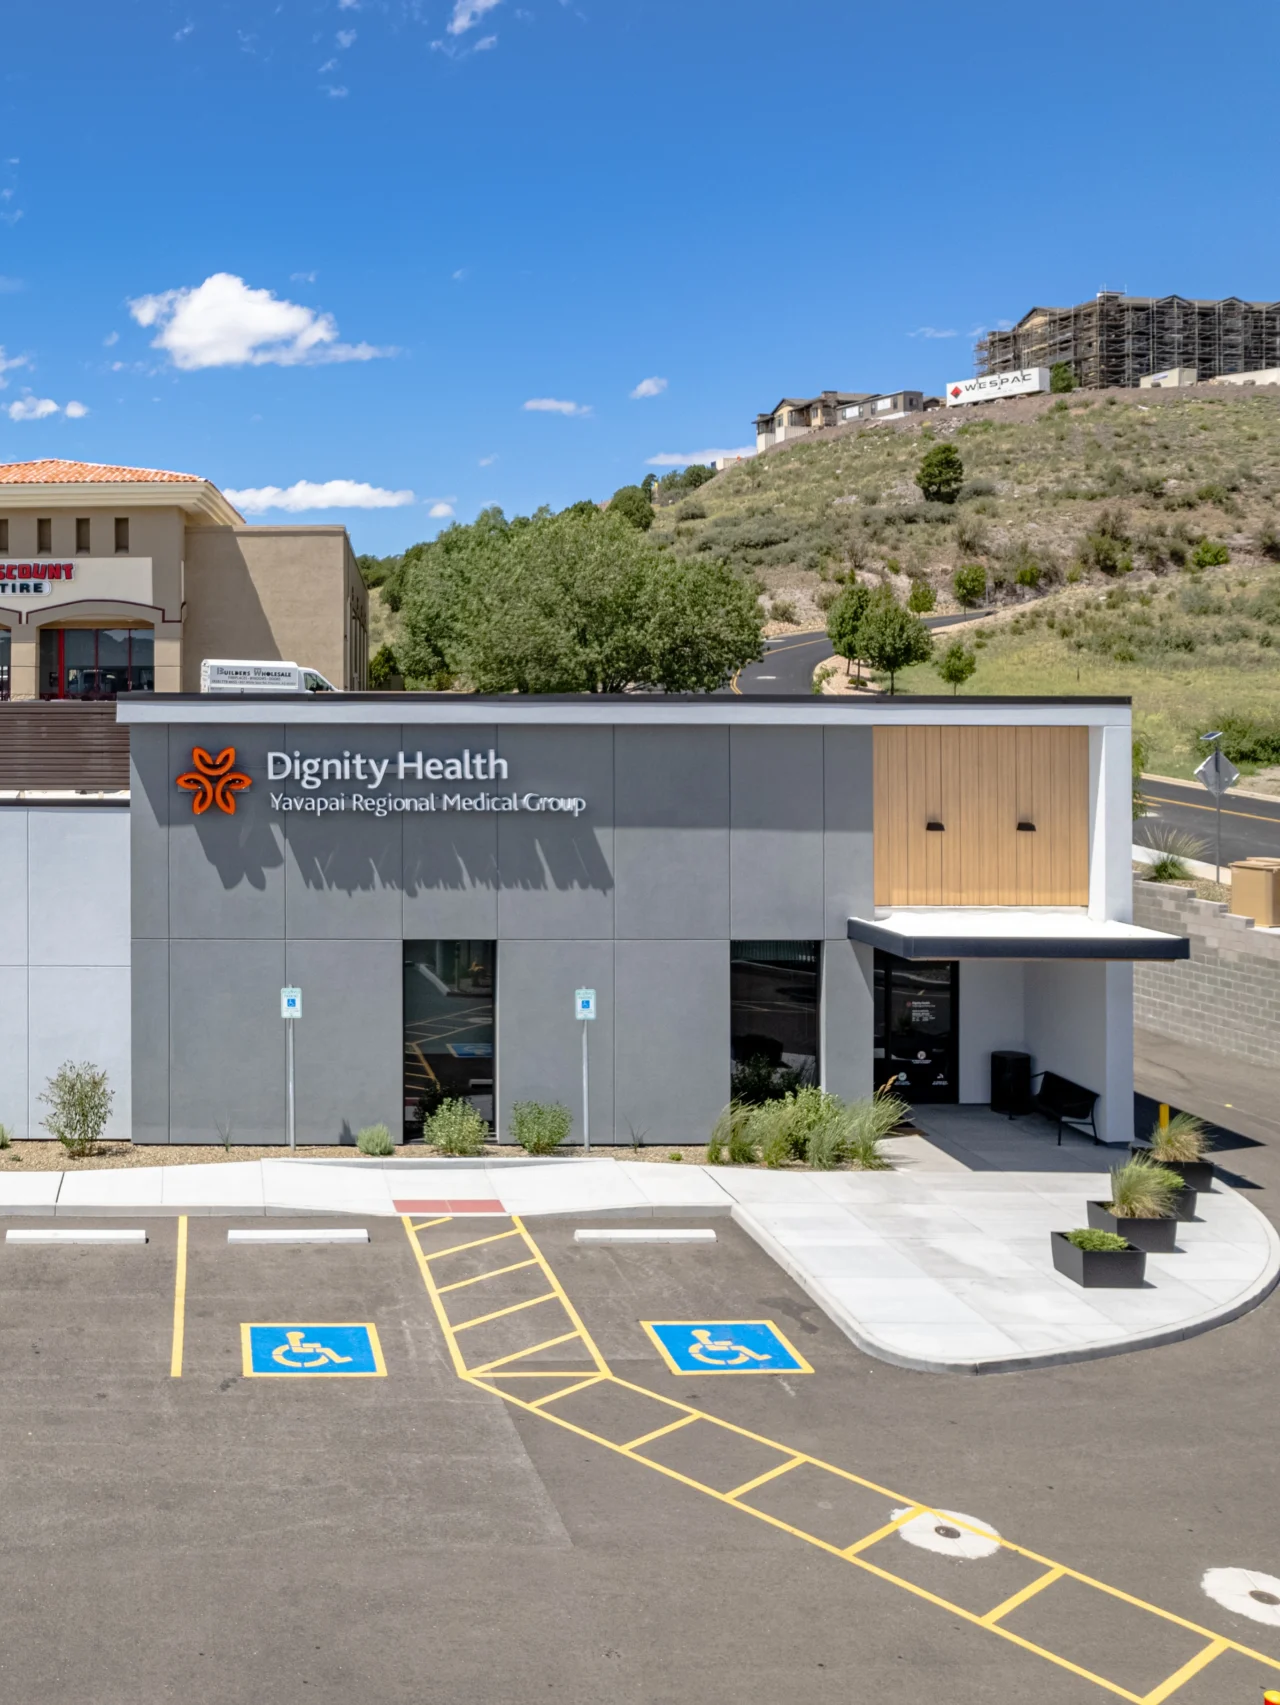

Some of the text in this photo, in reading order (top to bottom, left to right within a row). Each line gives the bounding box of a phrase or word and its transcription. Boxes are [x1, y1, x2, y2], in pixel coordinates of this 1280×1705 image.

[965, 374, 1032, 391] WESPAC
[267, 749, 509, 789] Dignity Health
[270, 792, 587, 817] Yavapai Regional Medical Group
